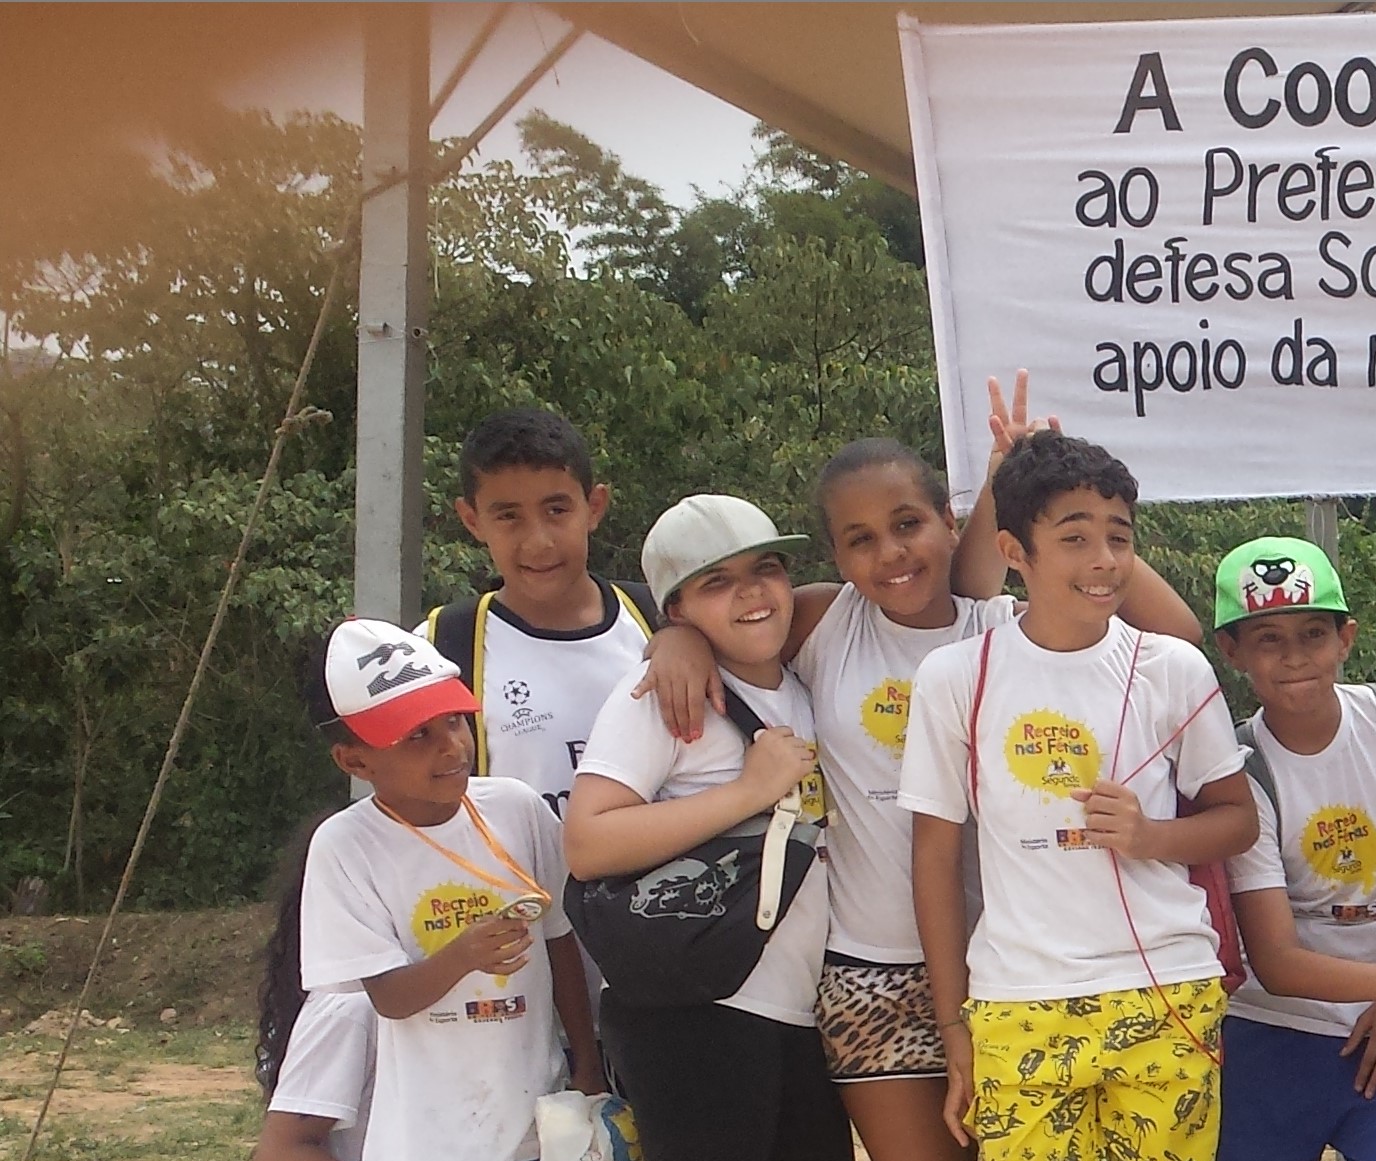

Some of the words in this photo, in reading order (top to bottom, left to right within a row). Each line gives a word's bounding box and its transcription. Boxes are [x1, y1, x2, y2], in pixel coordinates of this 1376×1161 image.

[1115, 51, 1182, 133] A
[1076, 168, 1160, 229] ao
[1084, 237, 1293, 304] defesa
[1093, 320, 1246, 418] apoio
[1271, 318, 1338, 386] da
[874, 702, 903, 715] nas
[500, 711, 554, 733] CHAMPIONS
[1023, 723, 1080, 740] Recreio
[1015, 741, 1043, 756] nas
[1047, 736, 1089, 756] Férias
[430, 892, 489, 916] Recreio
[424, 917, 452, 932] nas
